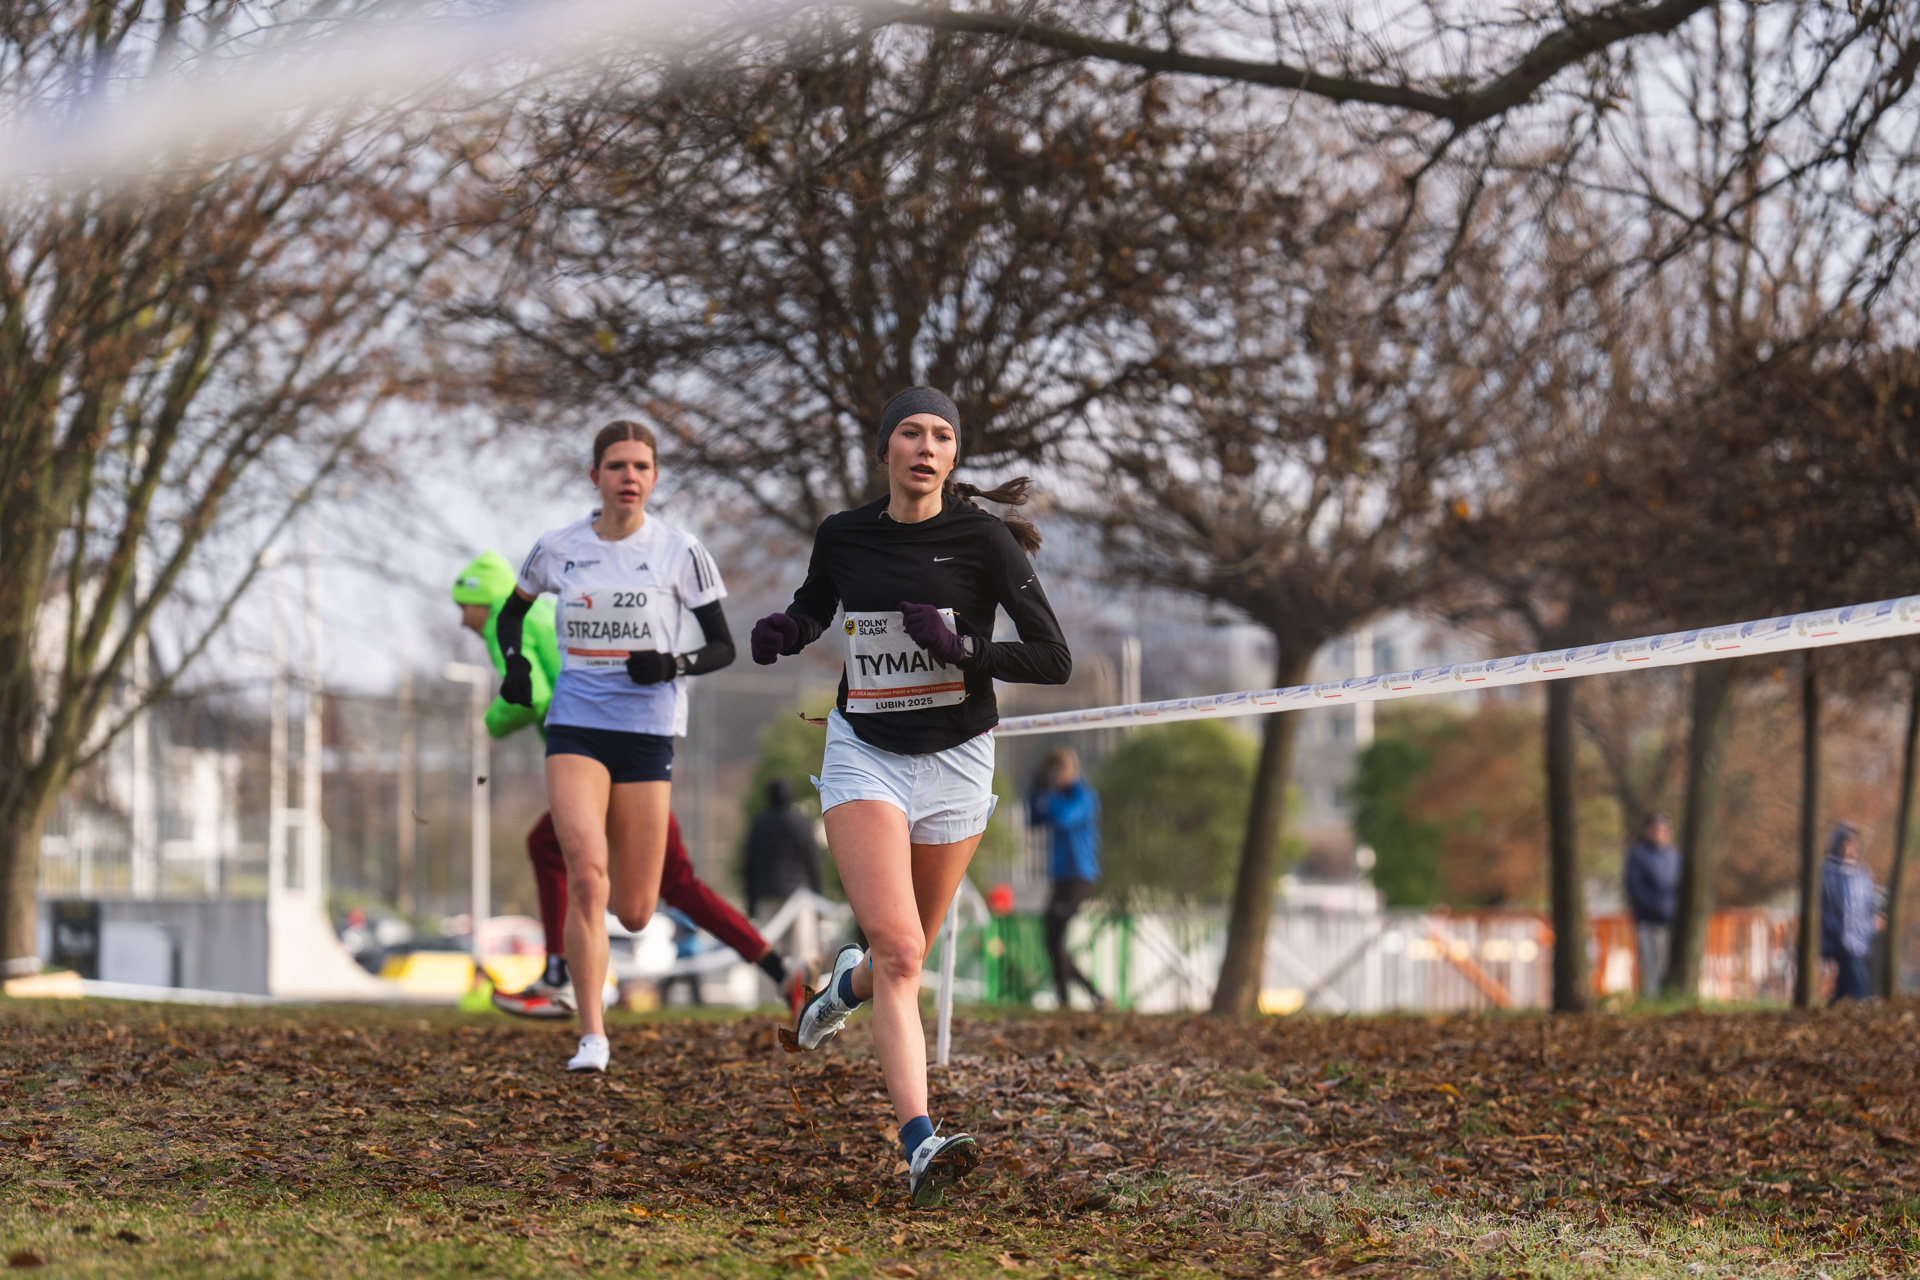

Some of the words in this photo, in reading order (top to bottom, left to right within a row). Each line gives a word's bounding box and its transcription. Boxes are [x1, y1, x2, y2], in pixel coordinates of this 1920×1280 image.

[613, 592, 647, 608] 220
[858, 618, 888, 628] DOLNY
[567, 620, 652, 643] STRZĄBAŁA
[875, 700, 905, 710] LUBIN
[907, 697, 933, 707] 2025
